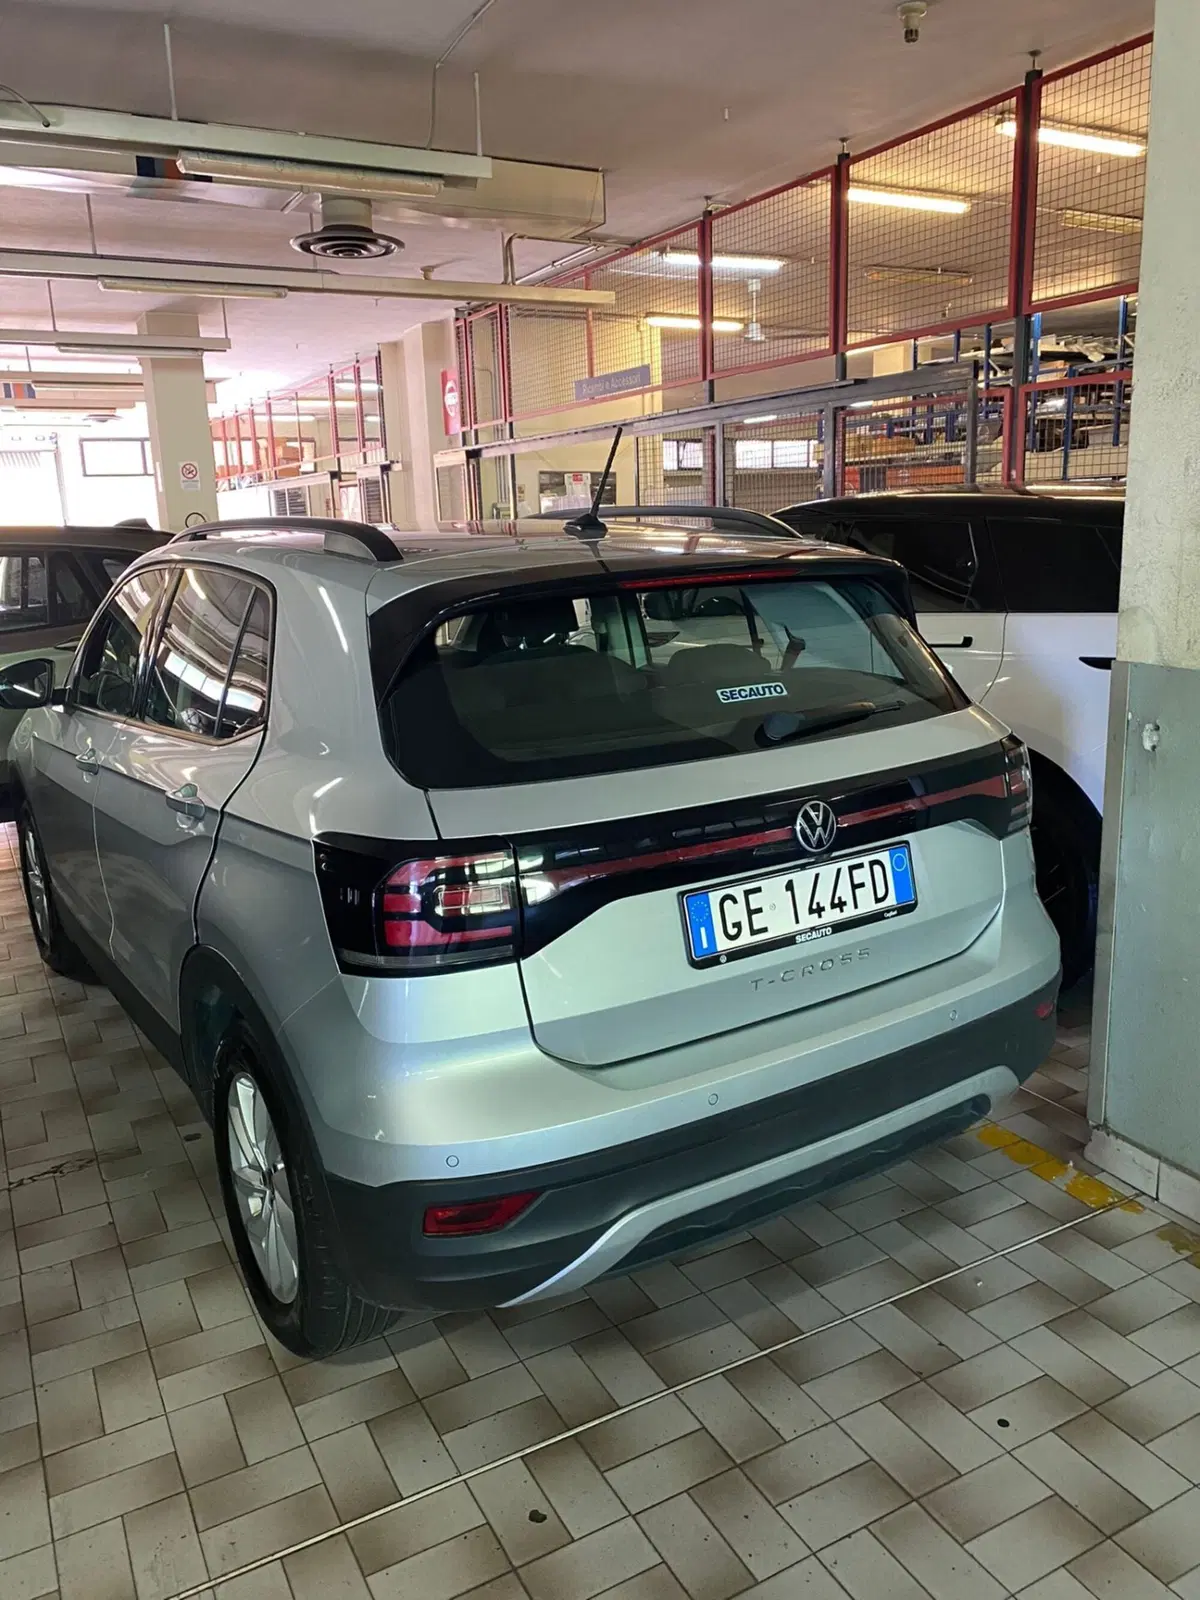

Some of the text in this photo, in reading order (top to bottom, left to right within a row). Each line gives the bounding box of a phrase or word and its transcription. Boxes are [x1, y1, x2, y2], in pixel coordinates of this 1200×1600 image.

[720, 684, 784, 701] SECAUTO
[718, 859, 890, 941] GE 144FD
[795, 926, 833, 944] SECAUTO
[750, 947, 871, 992] T-CROSS
